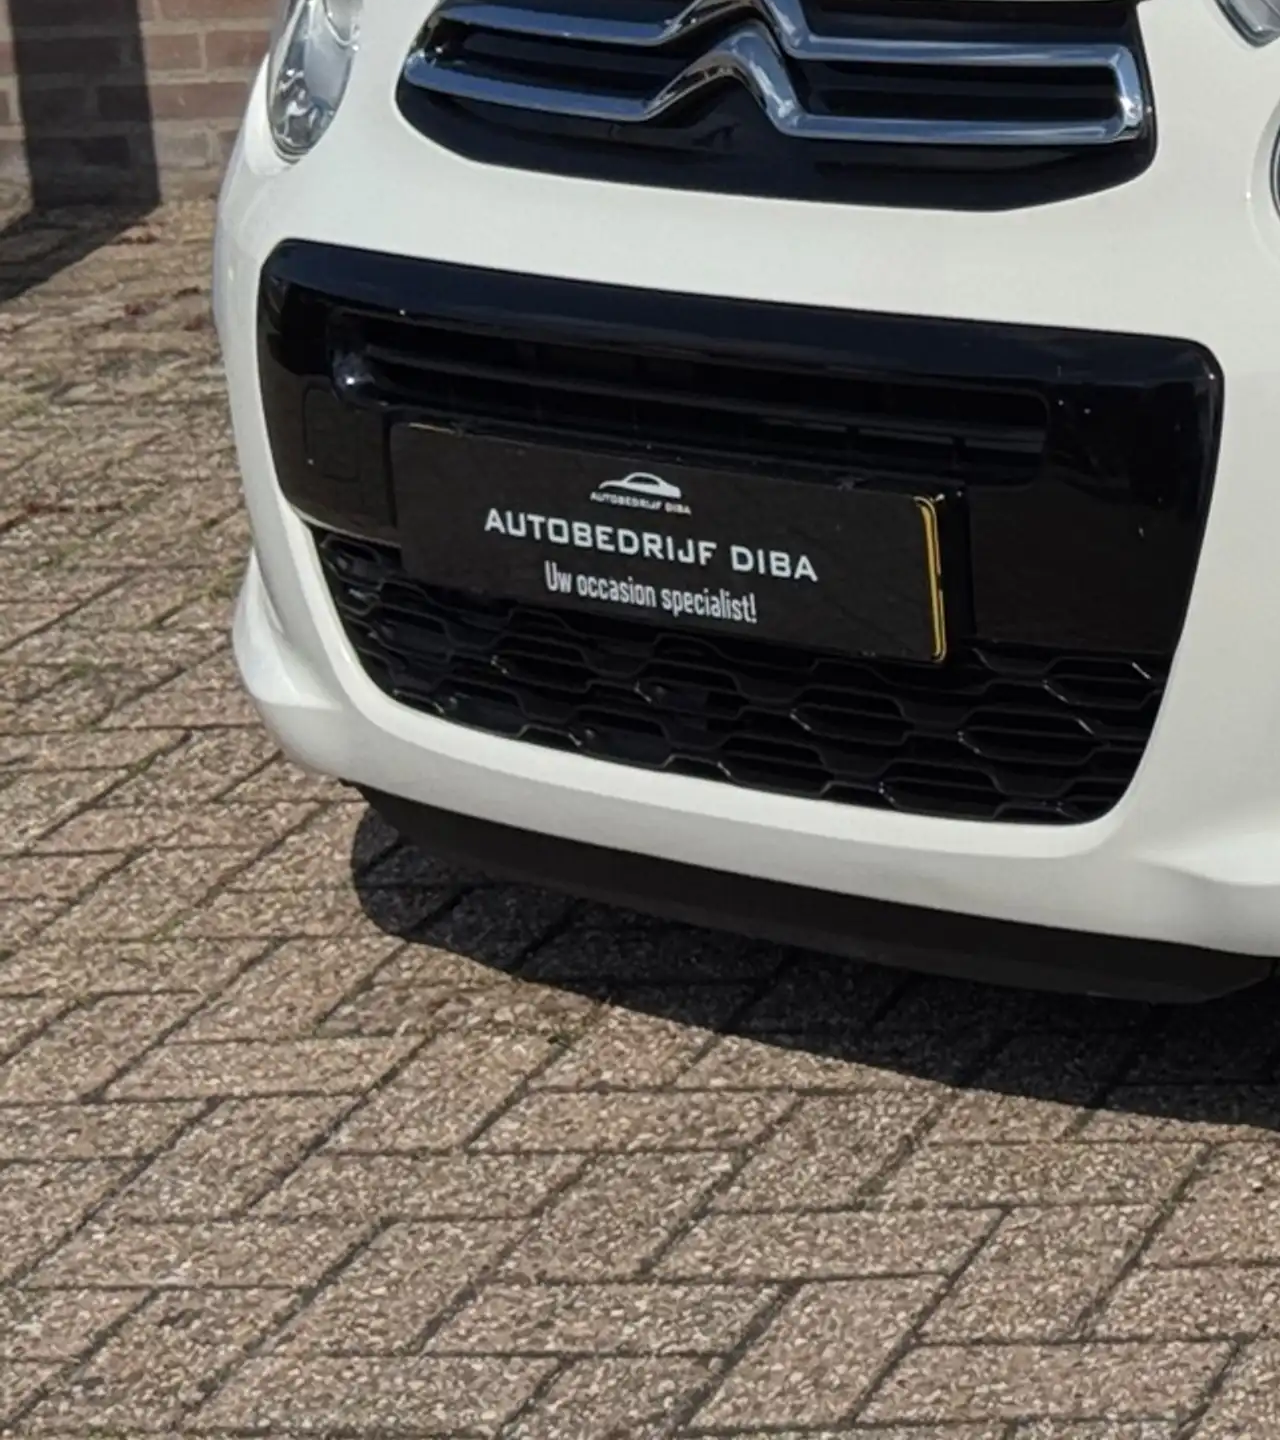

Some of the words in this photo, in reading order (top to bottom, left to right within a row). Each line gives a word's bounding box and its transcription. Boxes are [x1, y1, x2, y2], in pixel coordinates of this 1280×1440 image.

[589, 490, 664, 511] AUTOBEDRIJF
[663, 500, 692, 516] DIBA
[484, 507, 717, 565] AUTOBEDRIJF
[731, 544, 818, 582] DIBA
[545, 561, 573, 594] Uw
[576, 573, 656, 608] occasion
[660, 585, 757, 624] specialist!
